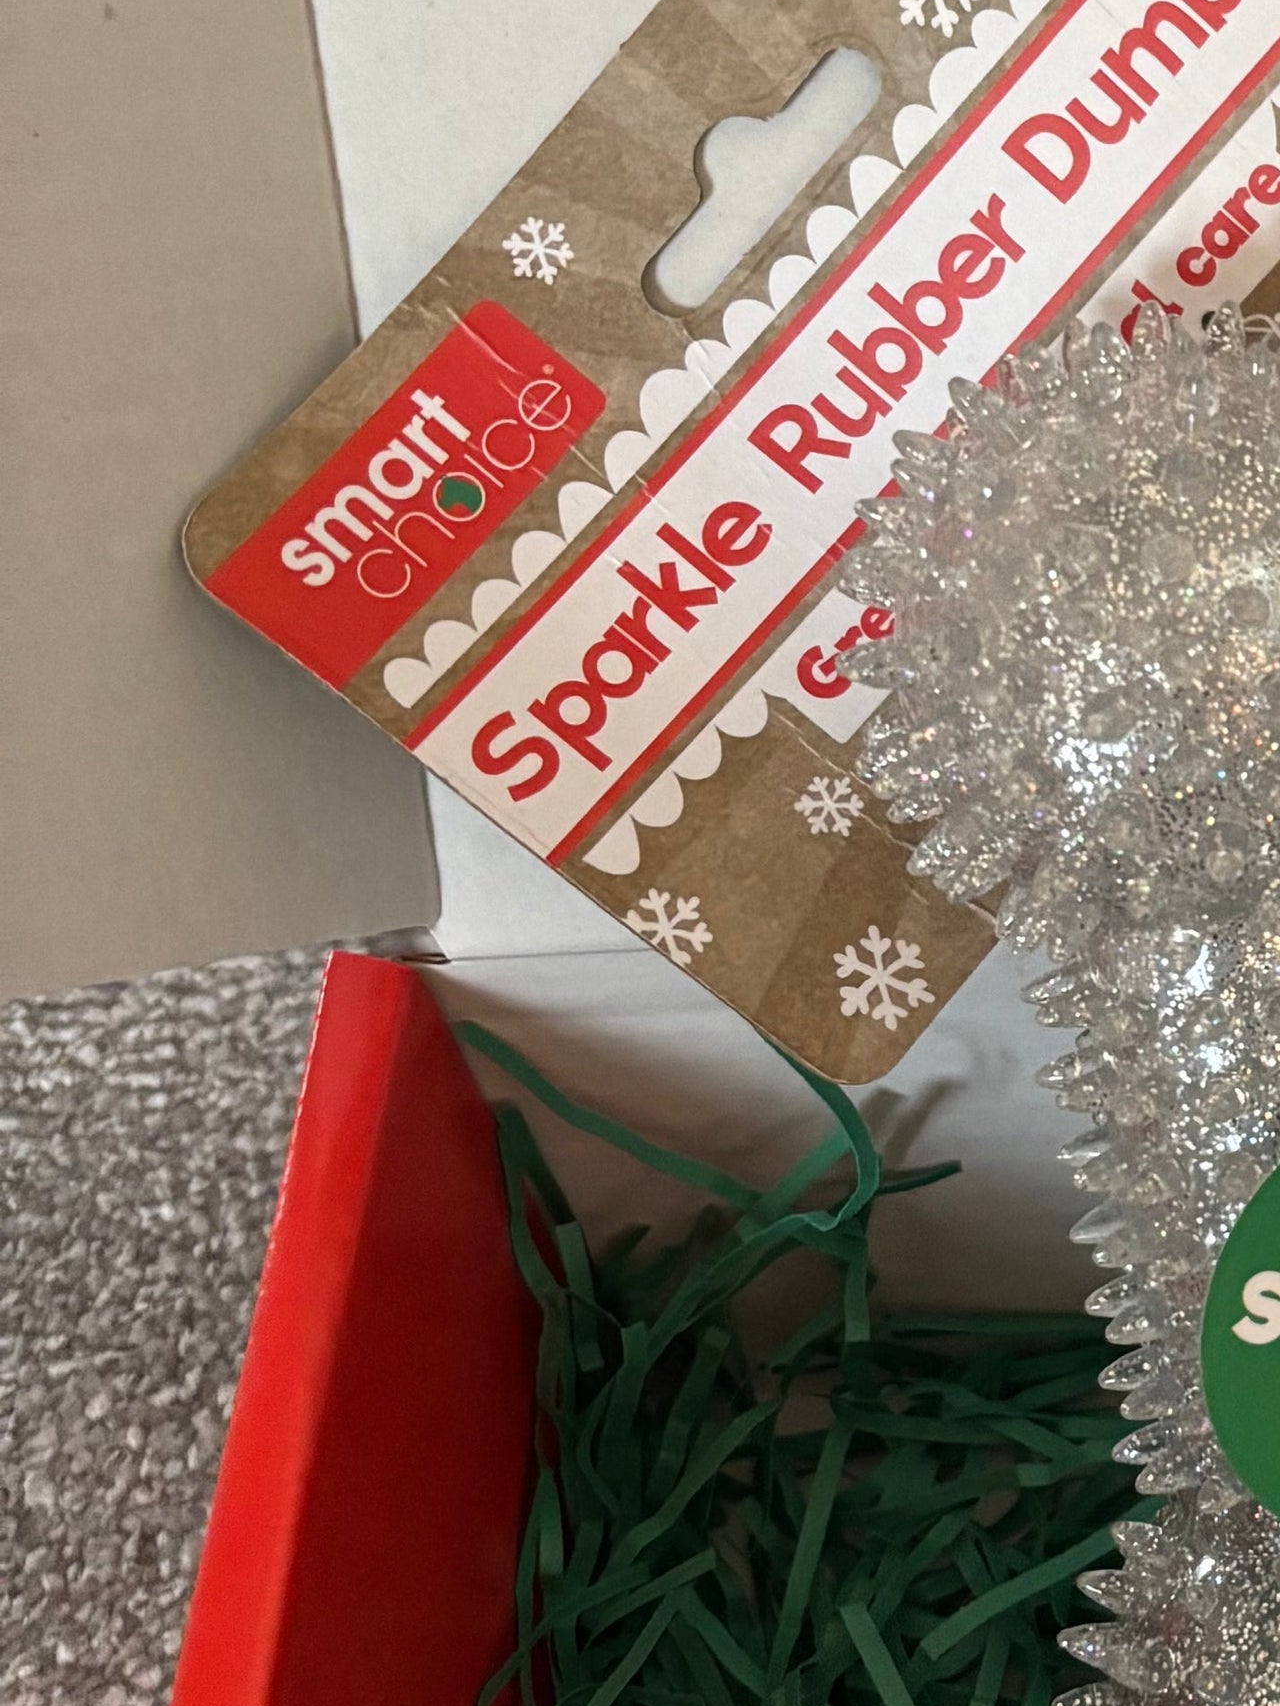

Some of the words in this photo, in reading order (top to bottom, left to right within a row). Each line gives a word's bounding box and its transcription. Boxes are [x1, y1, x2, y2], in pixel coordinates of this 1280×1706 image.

[281, 389, 471, 586] smart
[357, 379, 571, 598] choice
[472, 496, 773, 800] Sparkle
[748, 192, 1026, 495] Rubber
[797, 606, 895, 699] Gre
